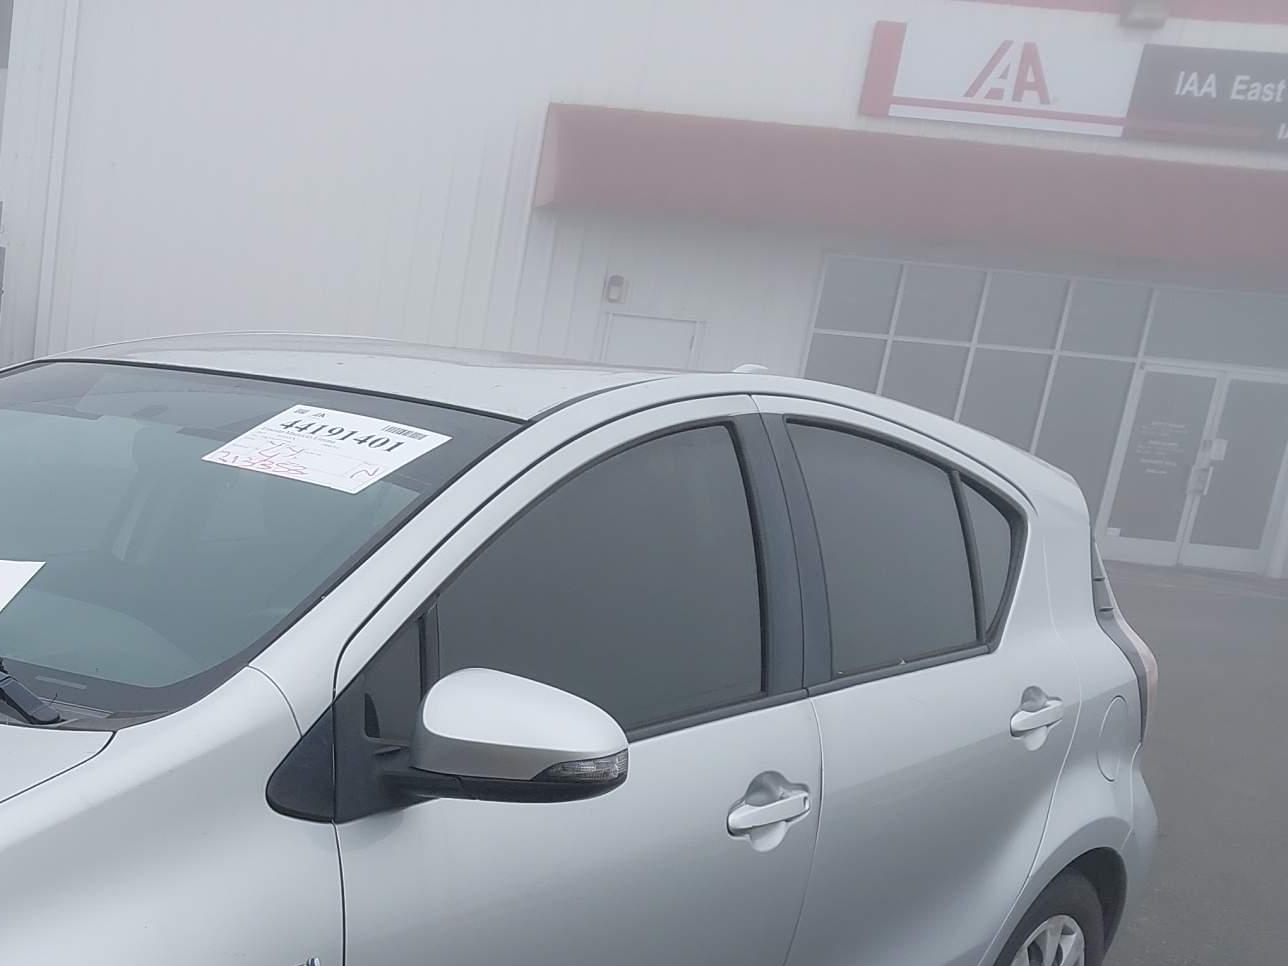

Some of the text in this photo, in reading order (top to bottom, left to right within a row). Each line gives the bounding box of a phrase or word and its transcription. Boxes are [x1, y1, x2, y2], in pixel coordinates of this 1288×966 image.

[1175, 71, 1287, 102] IAA East
[279, 419, 405, 452] 44191401
